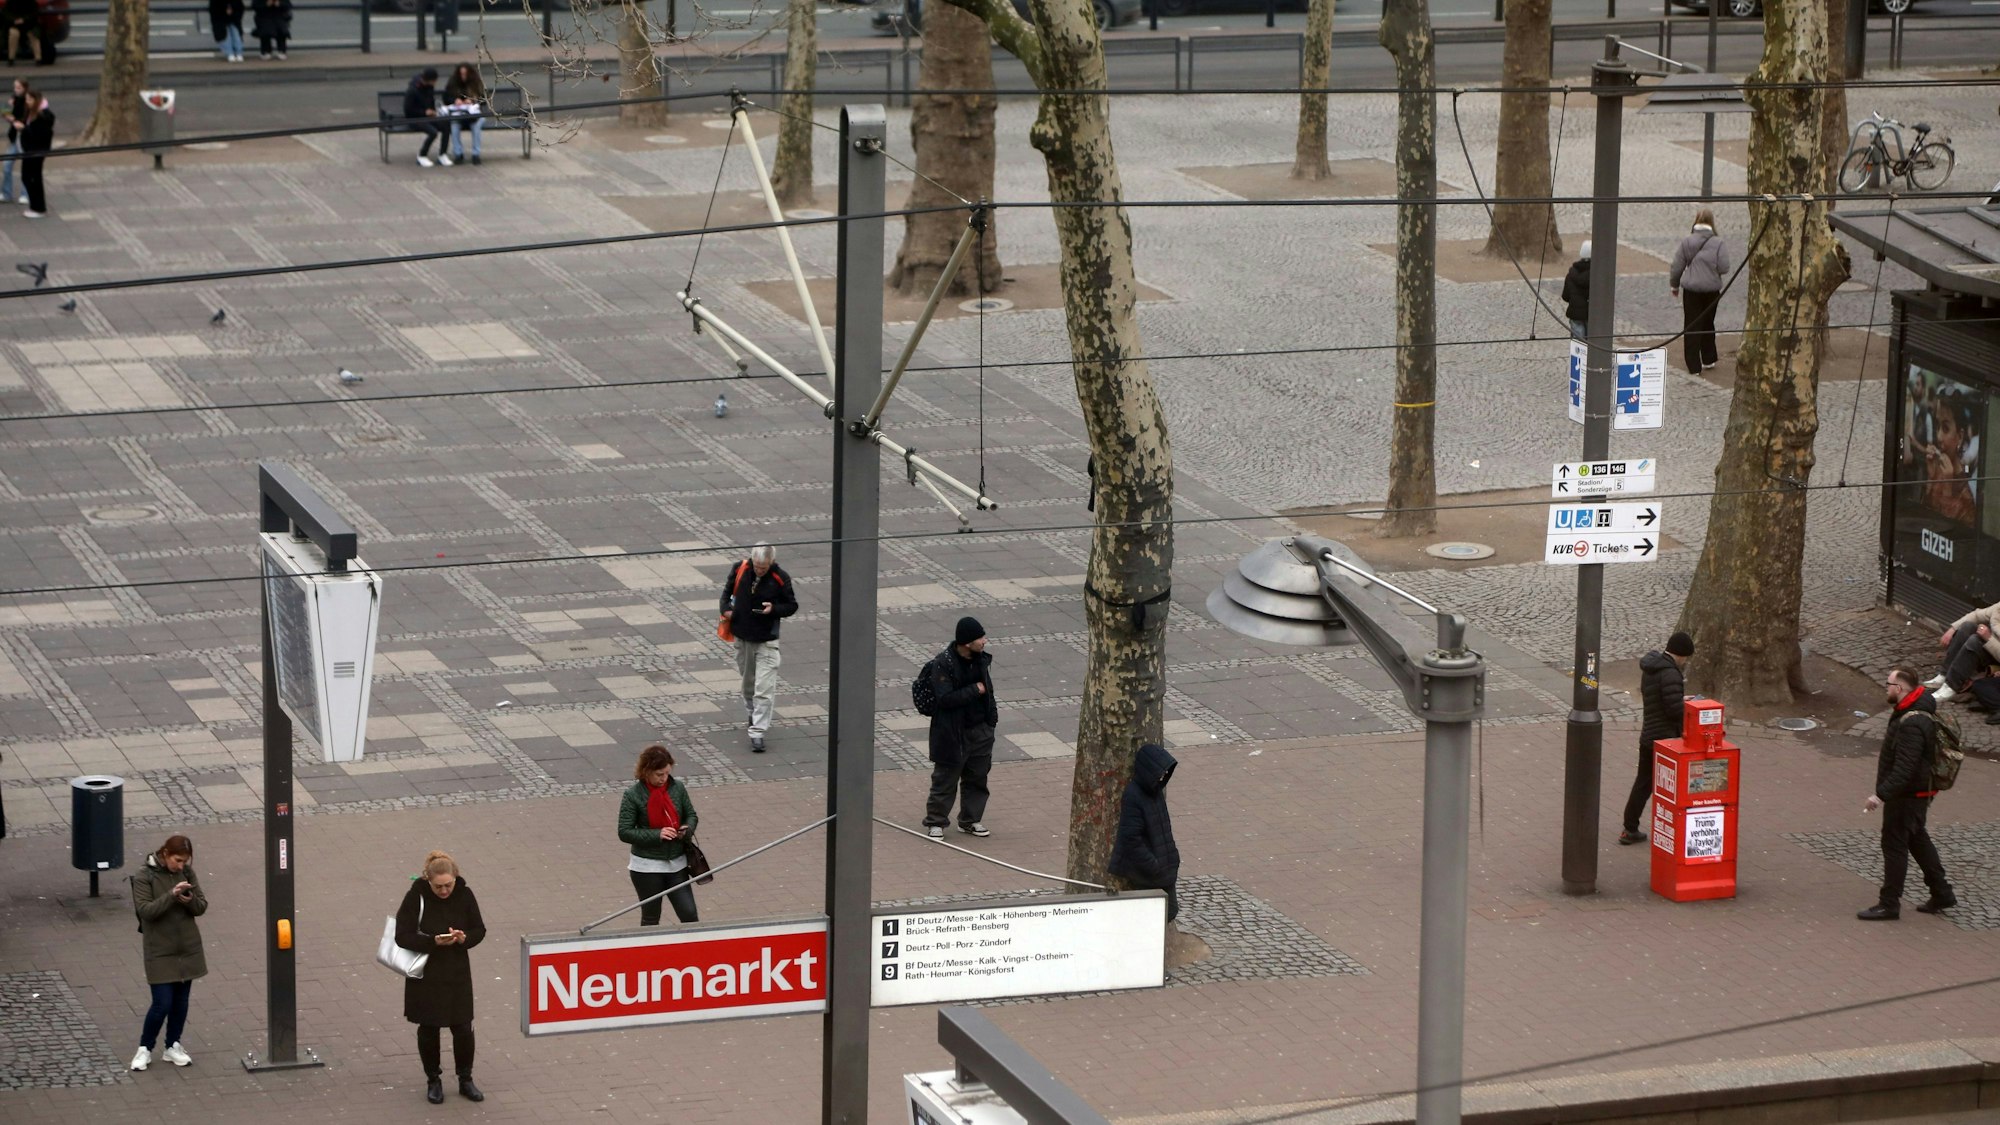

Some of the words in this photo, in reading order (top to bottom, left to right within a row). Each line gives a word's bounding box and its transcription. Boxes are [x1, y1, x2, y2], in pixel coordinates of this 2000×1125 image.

[1577, 486, 1612, 494] Sonderzüge
[1557, 510, 1571, 527] U
[1553, 544, 1574, 554] KVB
[1922, 528, 1953, 562] GIZEH
[1695, 819, 1716, 828] Trump
[1690, 827, 1720, 838] verhöhnt
[1694, 838, 1714, 848] Taylor
[1695, 847, 1713, 857] Swift
[906, 918, 916, 926] Bf
[917, 914, 974, 925] Deutz/Messe
[979, 913, 997, 921] Kalk
[1003, 909, 1047, 920] Höhenberg
[1052, 907, 1089, 916] Merheim
[906, 927, 930, 935] Brück
[935, 924, 966, 933] Refrath
[971, 922, 1009, 931] Bensberg
[936, 941, 951, 950] Poll
[956, 941, 974, 949] Porz
[979, 938, 1012, 947] Zündorf
[905, 962, 915, 970] Bf
[917, 958, 973, 969] Deutz/Messe
[979, 956, 997, 965] Kalk
[1002, 954, 1030, 964] Vingst
[1034, 952, 1069, 961] Ostheim
[905, 972, 925, 980] Rath
[930, 969, 962, 978] Heumar
[968, 966, 1015, 976] Königsforst
[537, 947, 818, 1012] Neumarkt
